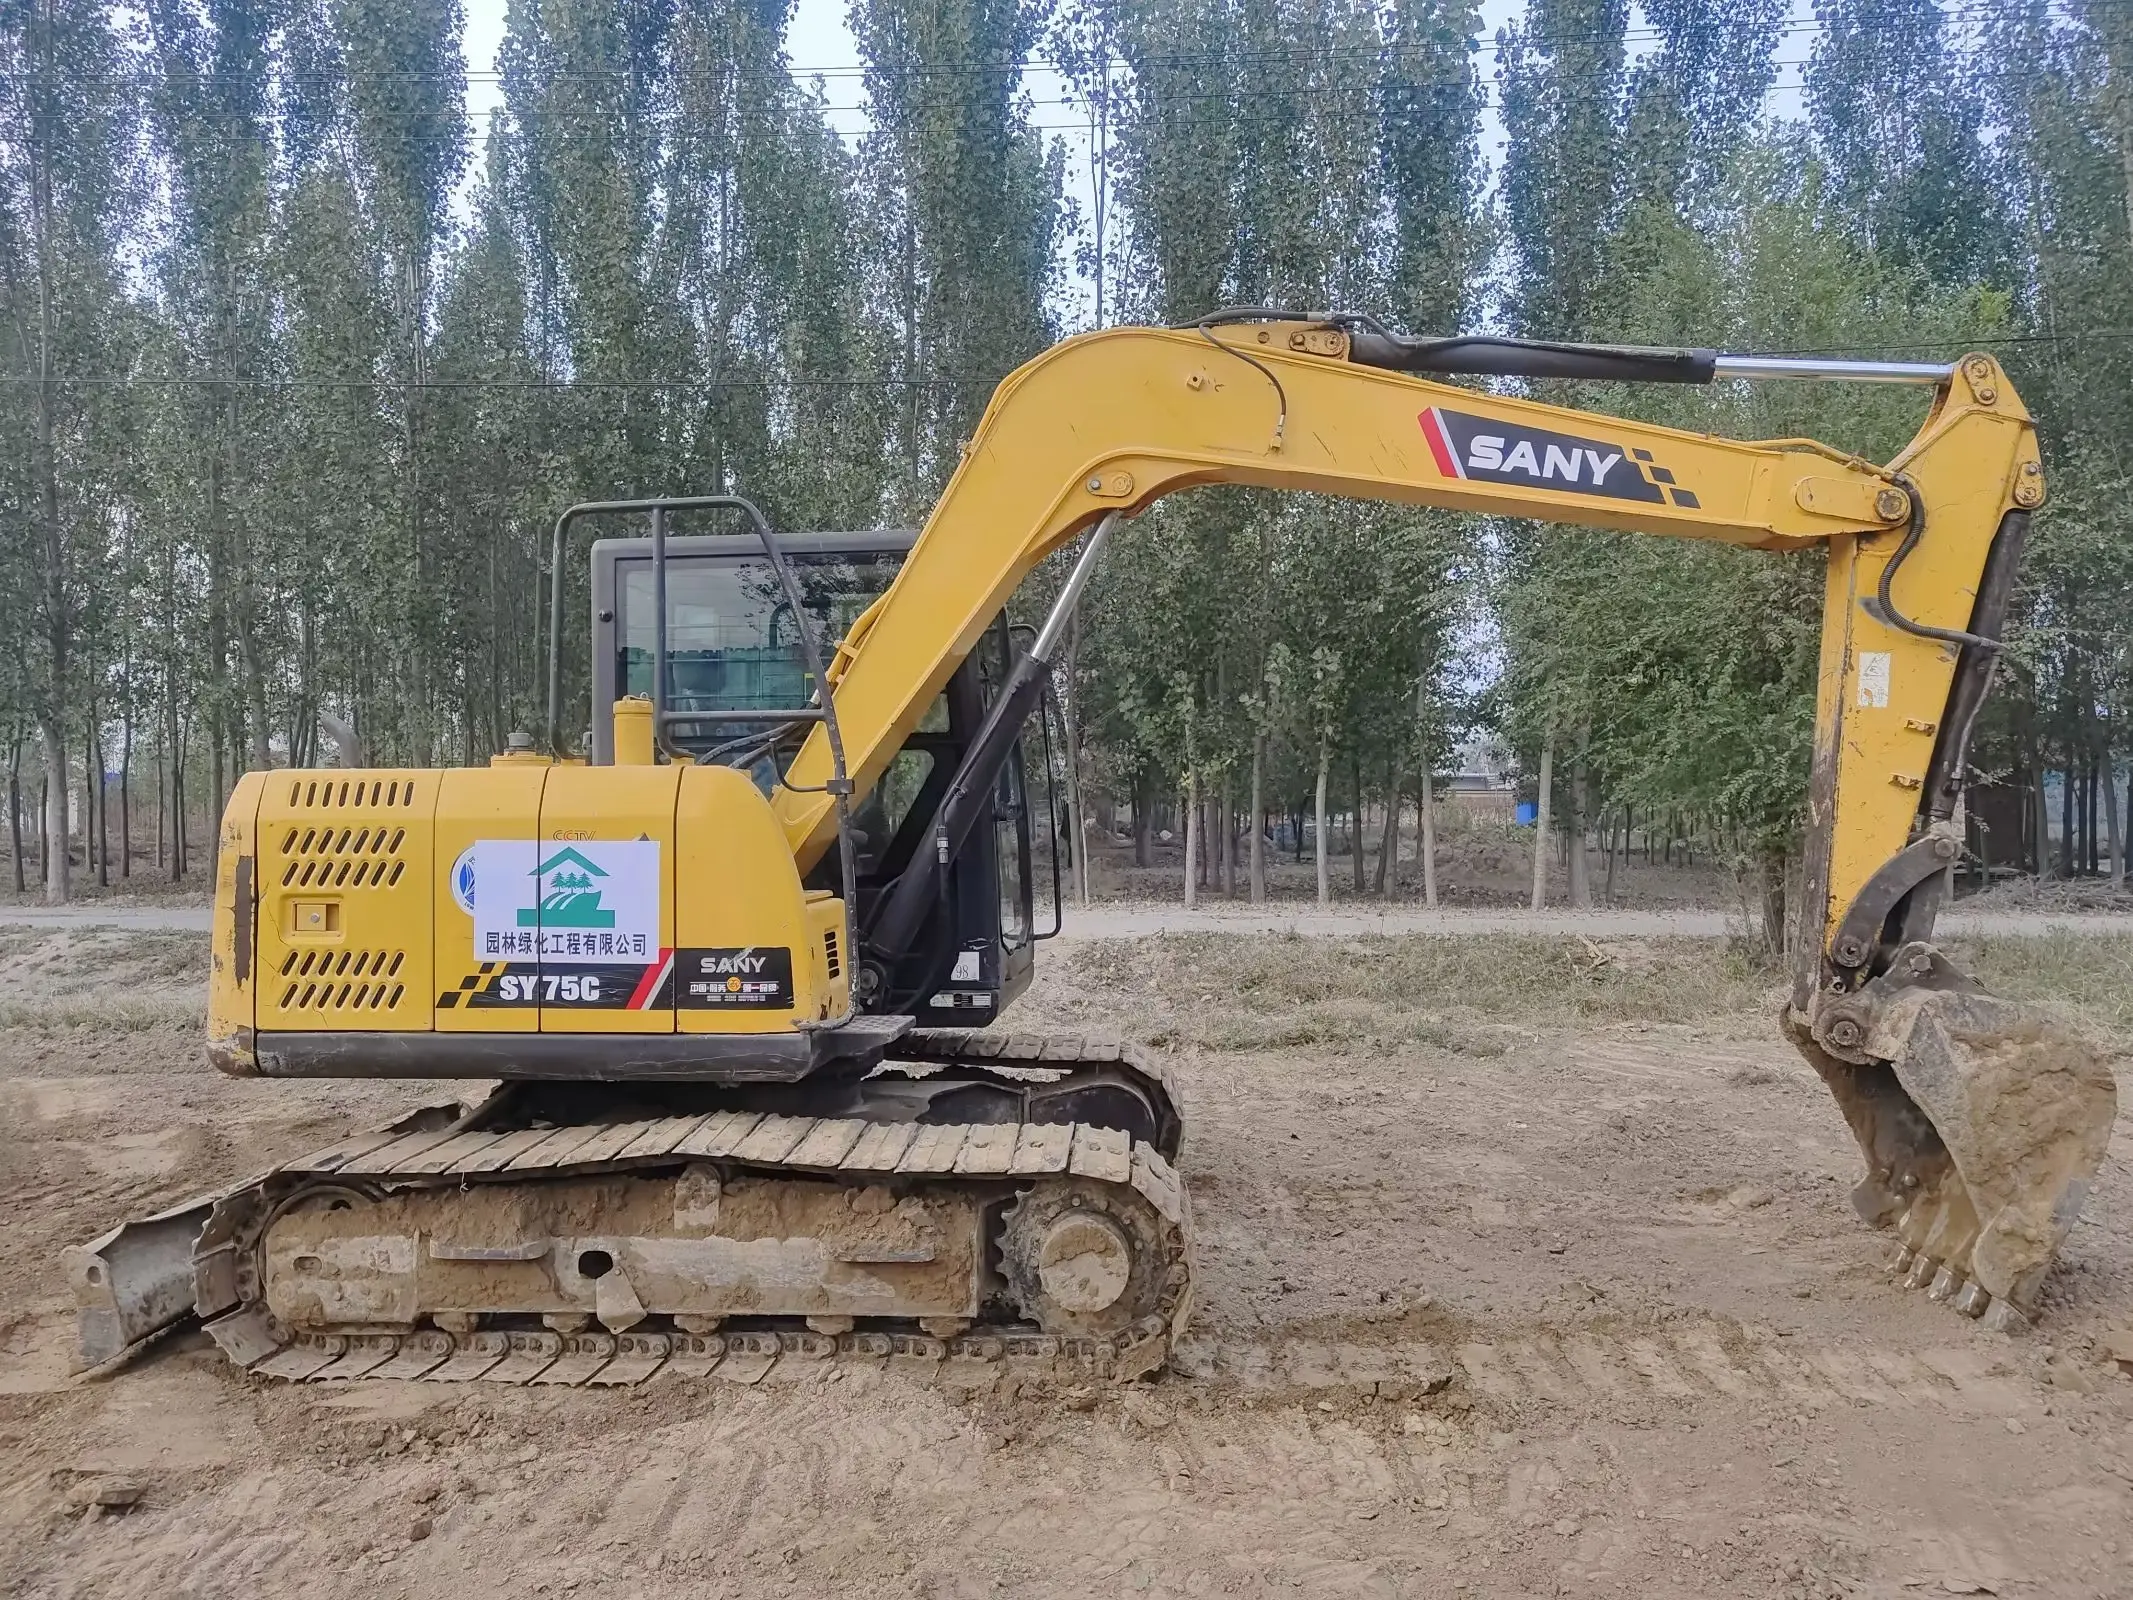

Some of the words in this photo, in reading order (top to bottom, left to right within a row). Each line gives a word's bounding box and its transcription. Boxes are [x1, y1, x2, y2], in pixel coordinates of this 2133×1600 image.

[1468, 434, 1623, 486] SANY
[552, 830, 596, 841] CCTV
[486, 931, 646, 956] 园林绿化工程有限公司
[700, 957, 766, 973] SANY
